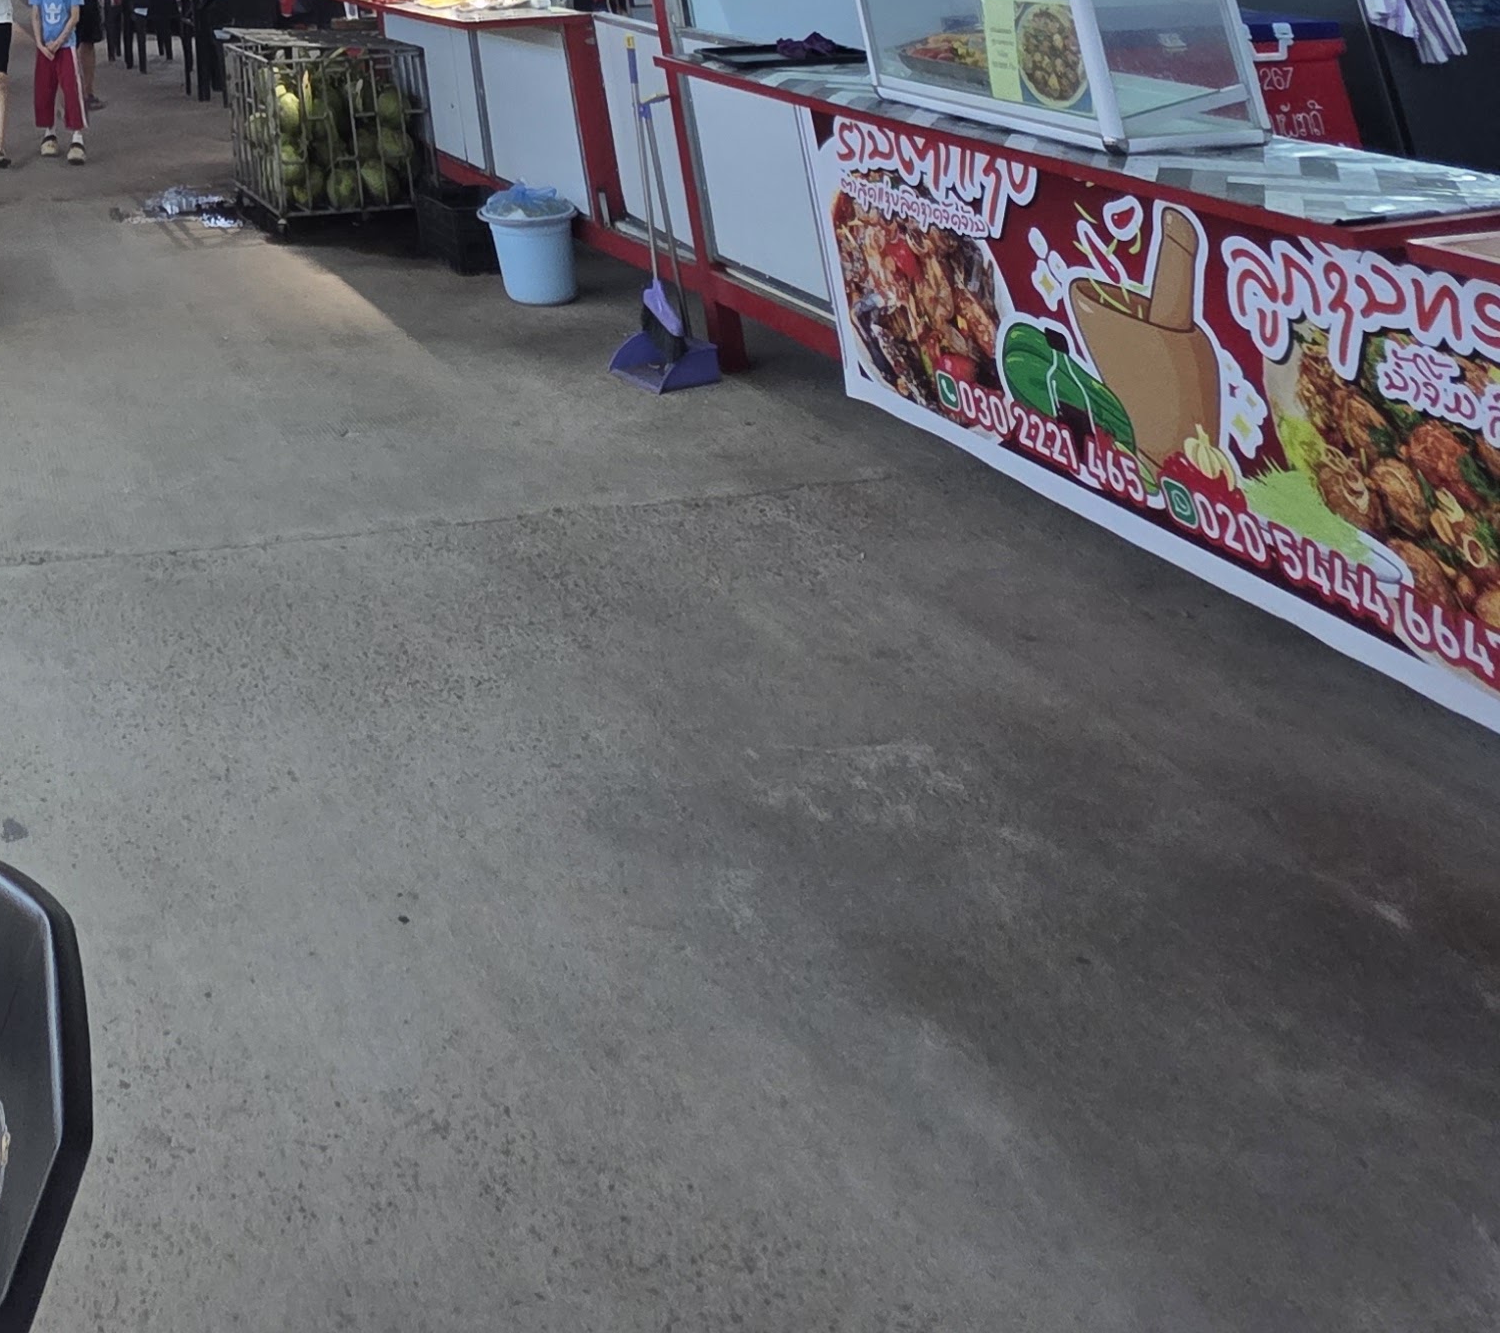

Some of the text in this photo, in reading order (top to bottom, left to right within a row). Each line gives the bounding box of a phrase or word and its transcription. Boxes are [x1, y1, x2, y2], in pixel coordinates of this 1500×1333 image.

[958, 379, 1500, 679] 030 2221 465 020 5444 664
